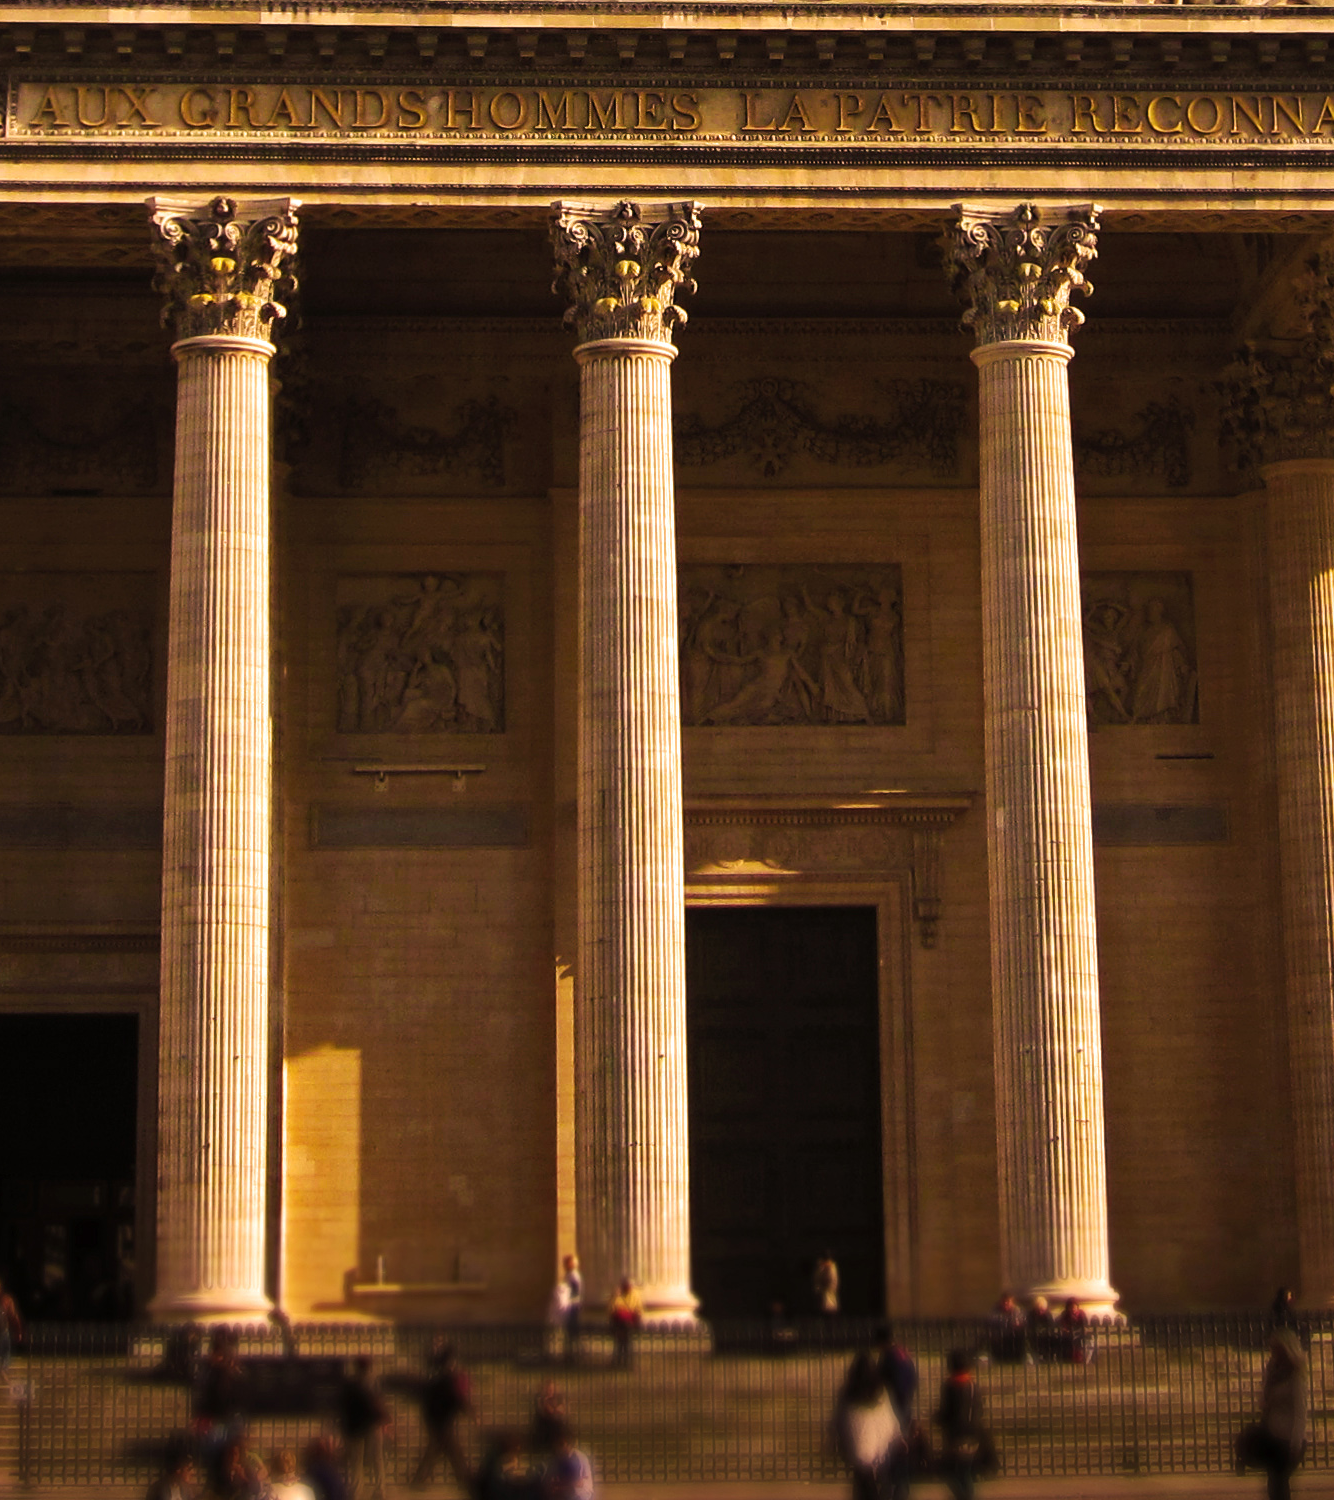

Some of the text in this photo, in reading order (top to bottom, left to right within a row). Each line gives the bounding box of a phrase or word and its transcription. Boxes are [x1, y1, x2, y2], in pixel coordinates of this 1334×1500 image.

[29, 85, 163, 127] AUX
[180, 86, 428, 129] GRANDS
[443, 90, 703, 131] HOMMES
[740, 93, 818, 132] LA
[835, 93, 1048, 133] PATRIE
